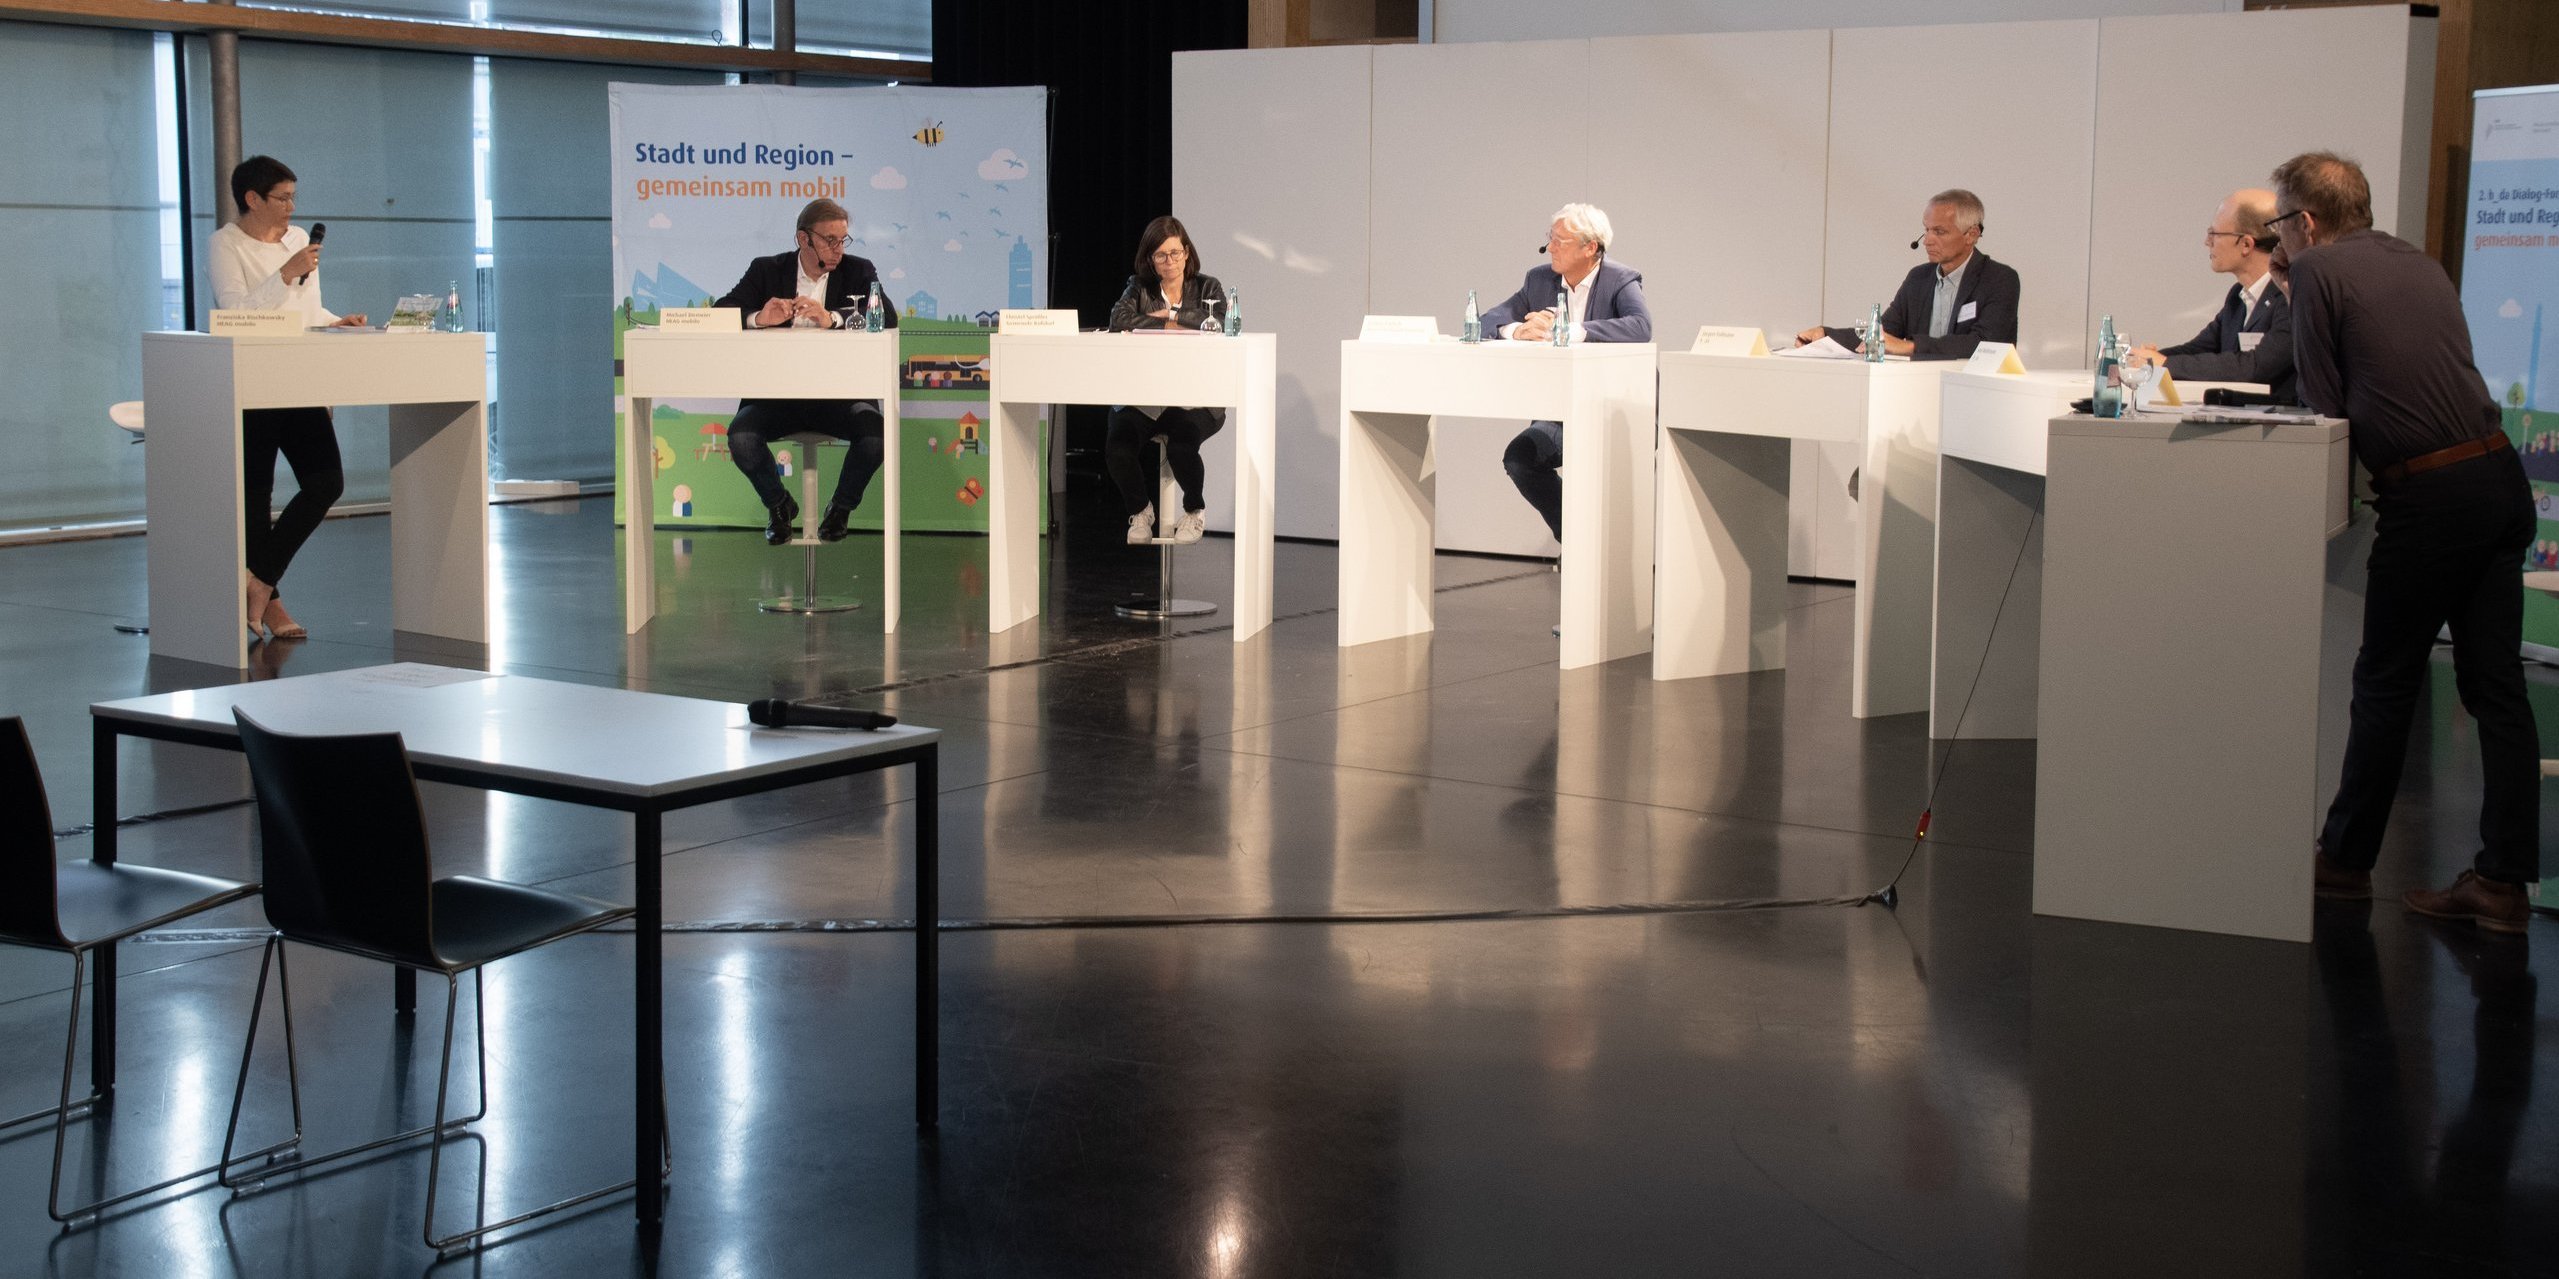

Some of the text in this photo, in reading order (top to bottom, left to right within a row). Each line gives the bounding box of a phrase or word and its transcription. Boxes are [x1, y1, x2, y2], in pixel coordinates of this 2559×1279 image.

[635, 142, 695, 164] Stadt
[703, 142, 746, 164] und
[755, 144, 834, 171] Region
[636, 175, 845, 201] gemeinsam mobil
[2478, 189, 2487, 201] 2.
[2476, 208, 2506, 224] Stadt
[2509, 207, 2534, 224] und
[2474, 235, 2544, 252] gemeinsam
